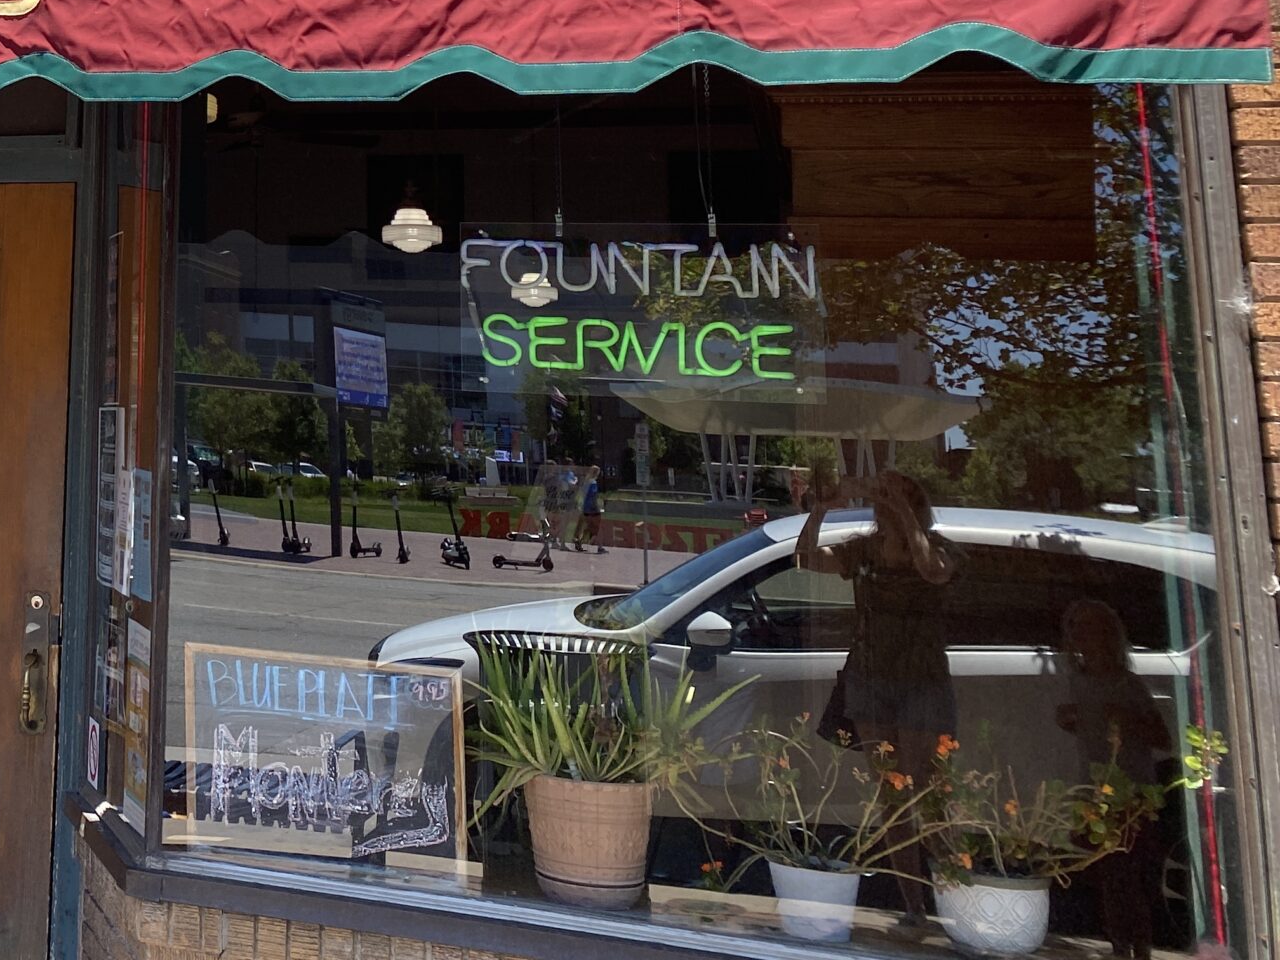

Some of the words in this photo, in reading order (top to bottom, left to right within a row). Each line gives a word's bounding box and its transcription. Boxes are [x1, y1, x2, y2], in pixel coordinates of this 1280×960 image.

[460, 239, 816, 299] FOUNTAIN
[482, 313, 796, 380] SERVICE
[207, 658, 289, 712] BLUE
